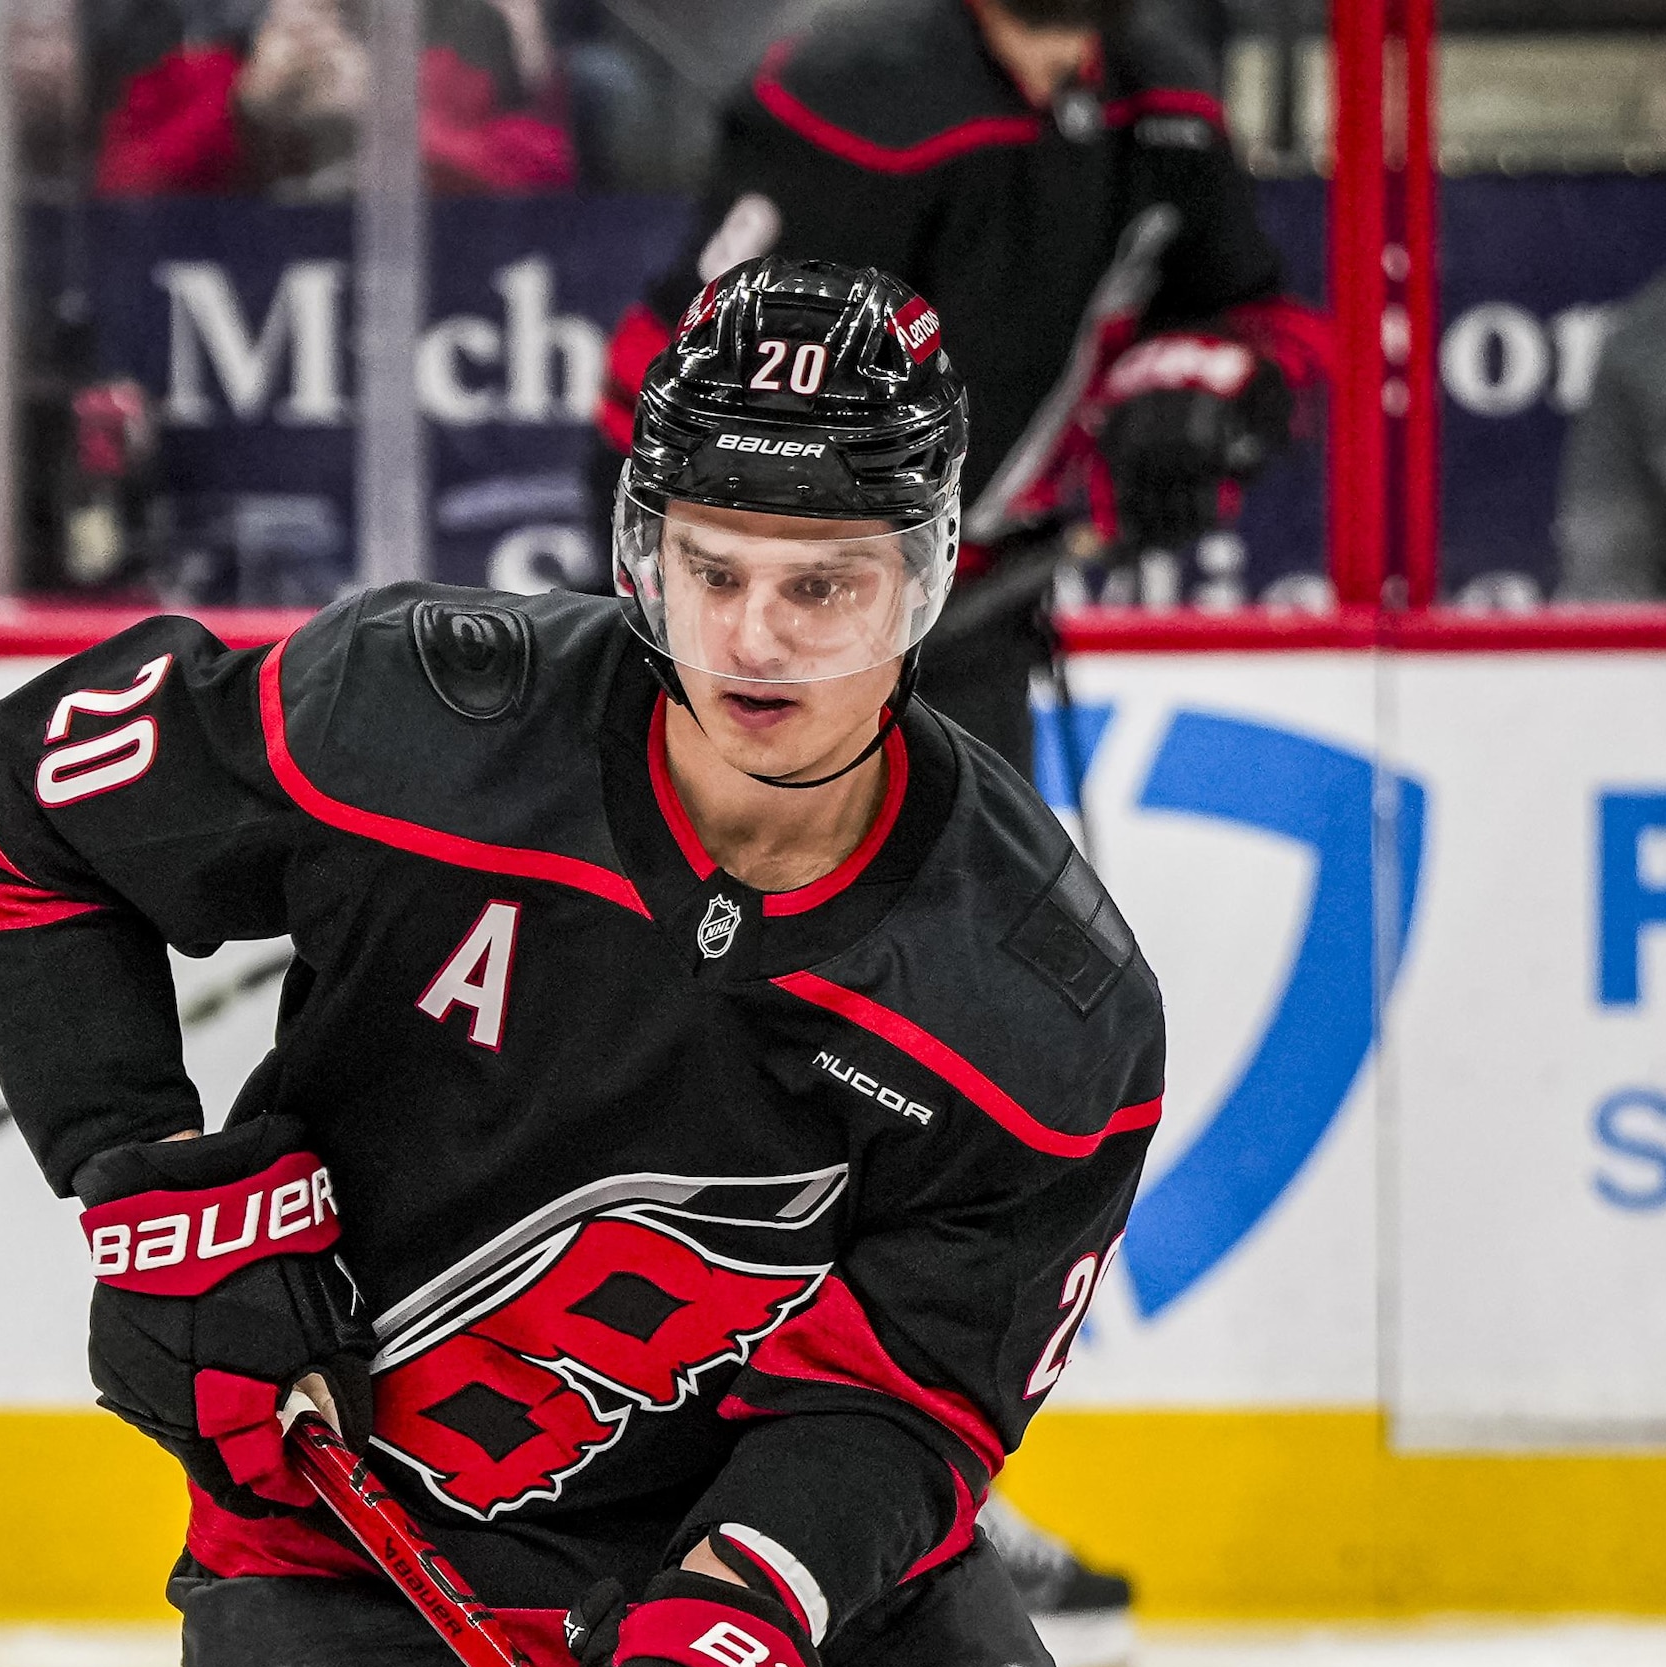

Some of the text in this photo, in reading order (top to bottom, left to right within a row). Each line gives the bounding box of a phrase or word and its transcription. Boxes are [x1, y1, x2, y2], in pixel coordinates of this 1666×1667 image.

[749, 340, 827, 395] 20
[716, 433, 826, 459] BAUER
[36, 653, 174, 808] 20
[704, 919, 732, 940] NHL
[415, 900, 521, 1052] A
[812, 1051, 933, 1125] NUCOR
[92, 1166, 338, 1276] BAUER
[394, 1560, 464, 1638] BAUER
